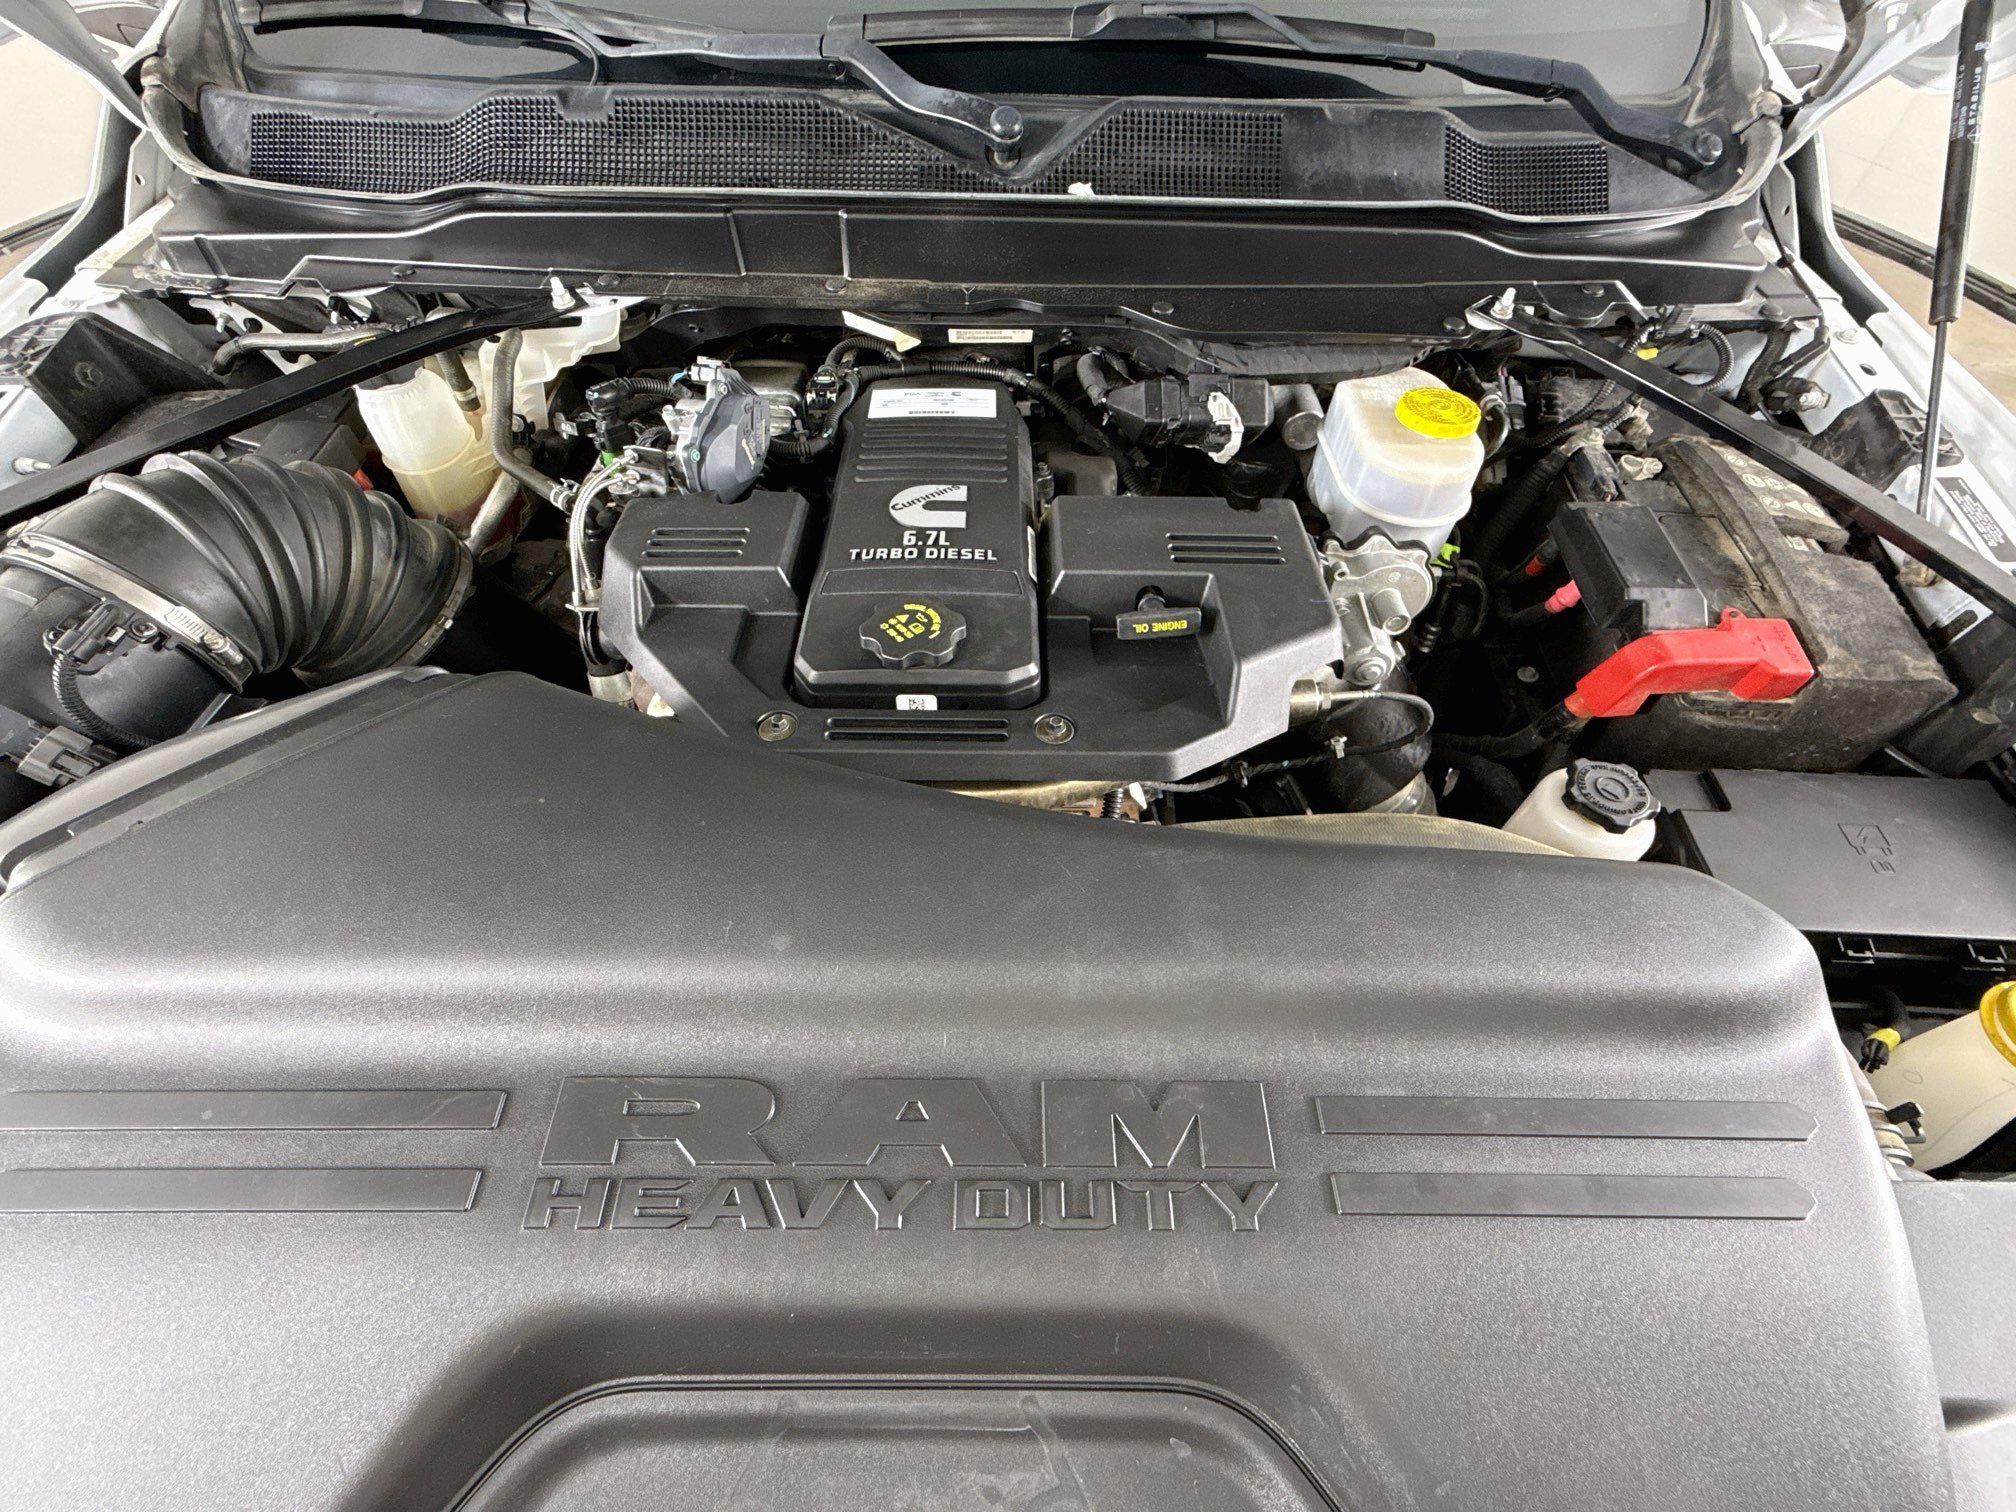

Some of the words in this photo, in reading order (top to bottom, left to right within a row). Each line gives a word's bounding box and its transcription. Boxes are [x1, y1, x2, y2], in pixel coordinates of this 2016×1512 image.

[891, 485, 961, 511] Cummins
[903, 530, 950, 547] 6.7L
[850, 548, 918, 561] TURBO
[925, 548, 998, 561] DIESEL
[1132, 623, 1149, 633] OIL
[1151, 619, 1188, 632] ENGINE
[540, 1076, 1277, 1169] RAM
[521, 1177, 933, 1230] HEAVY
[952, 1180, 1280, 1231] DUTY
